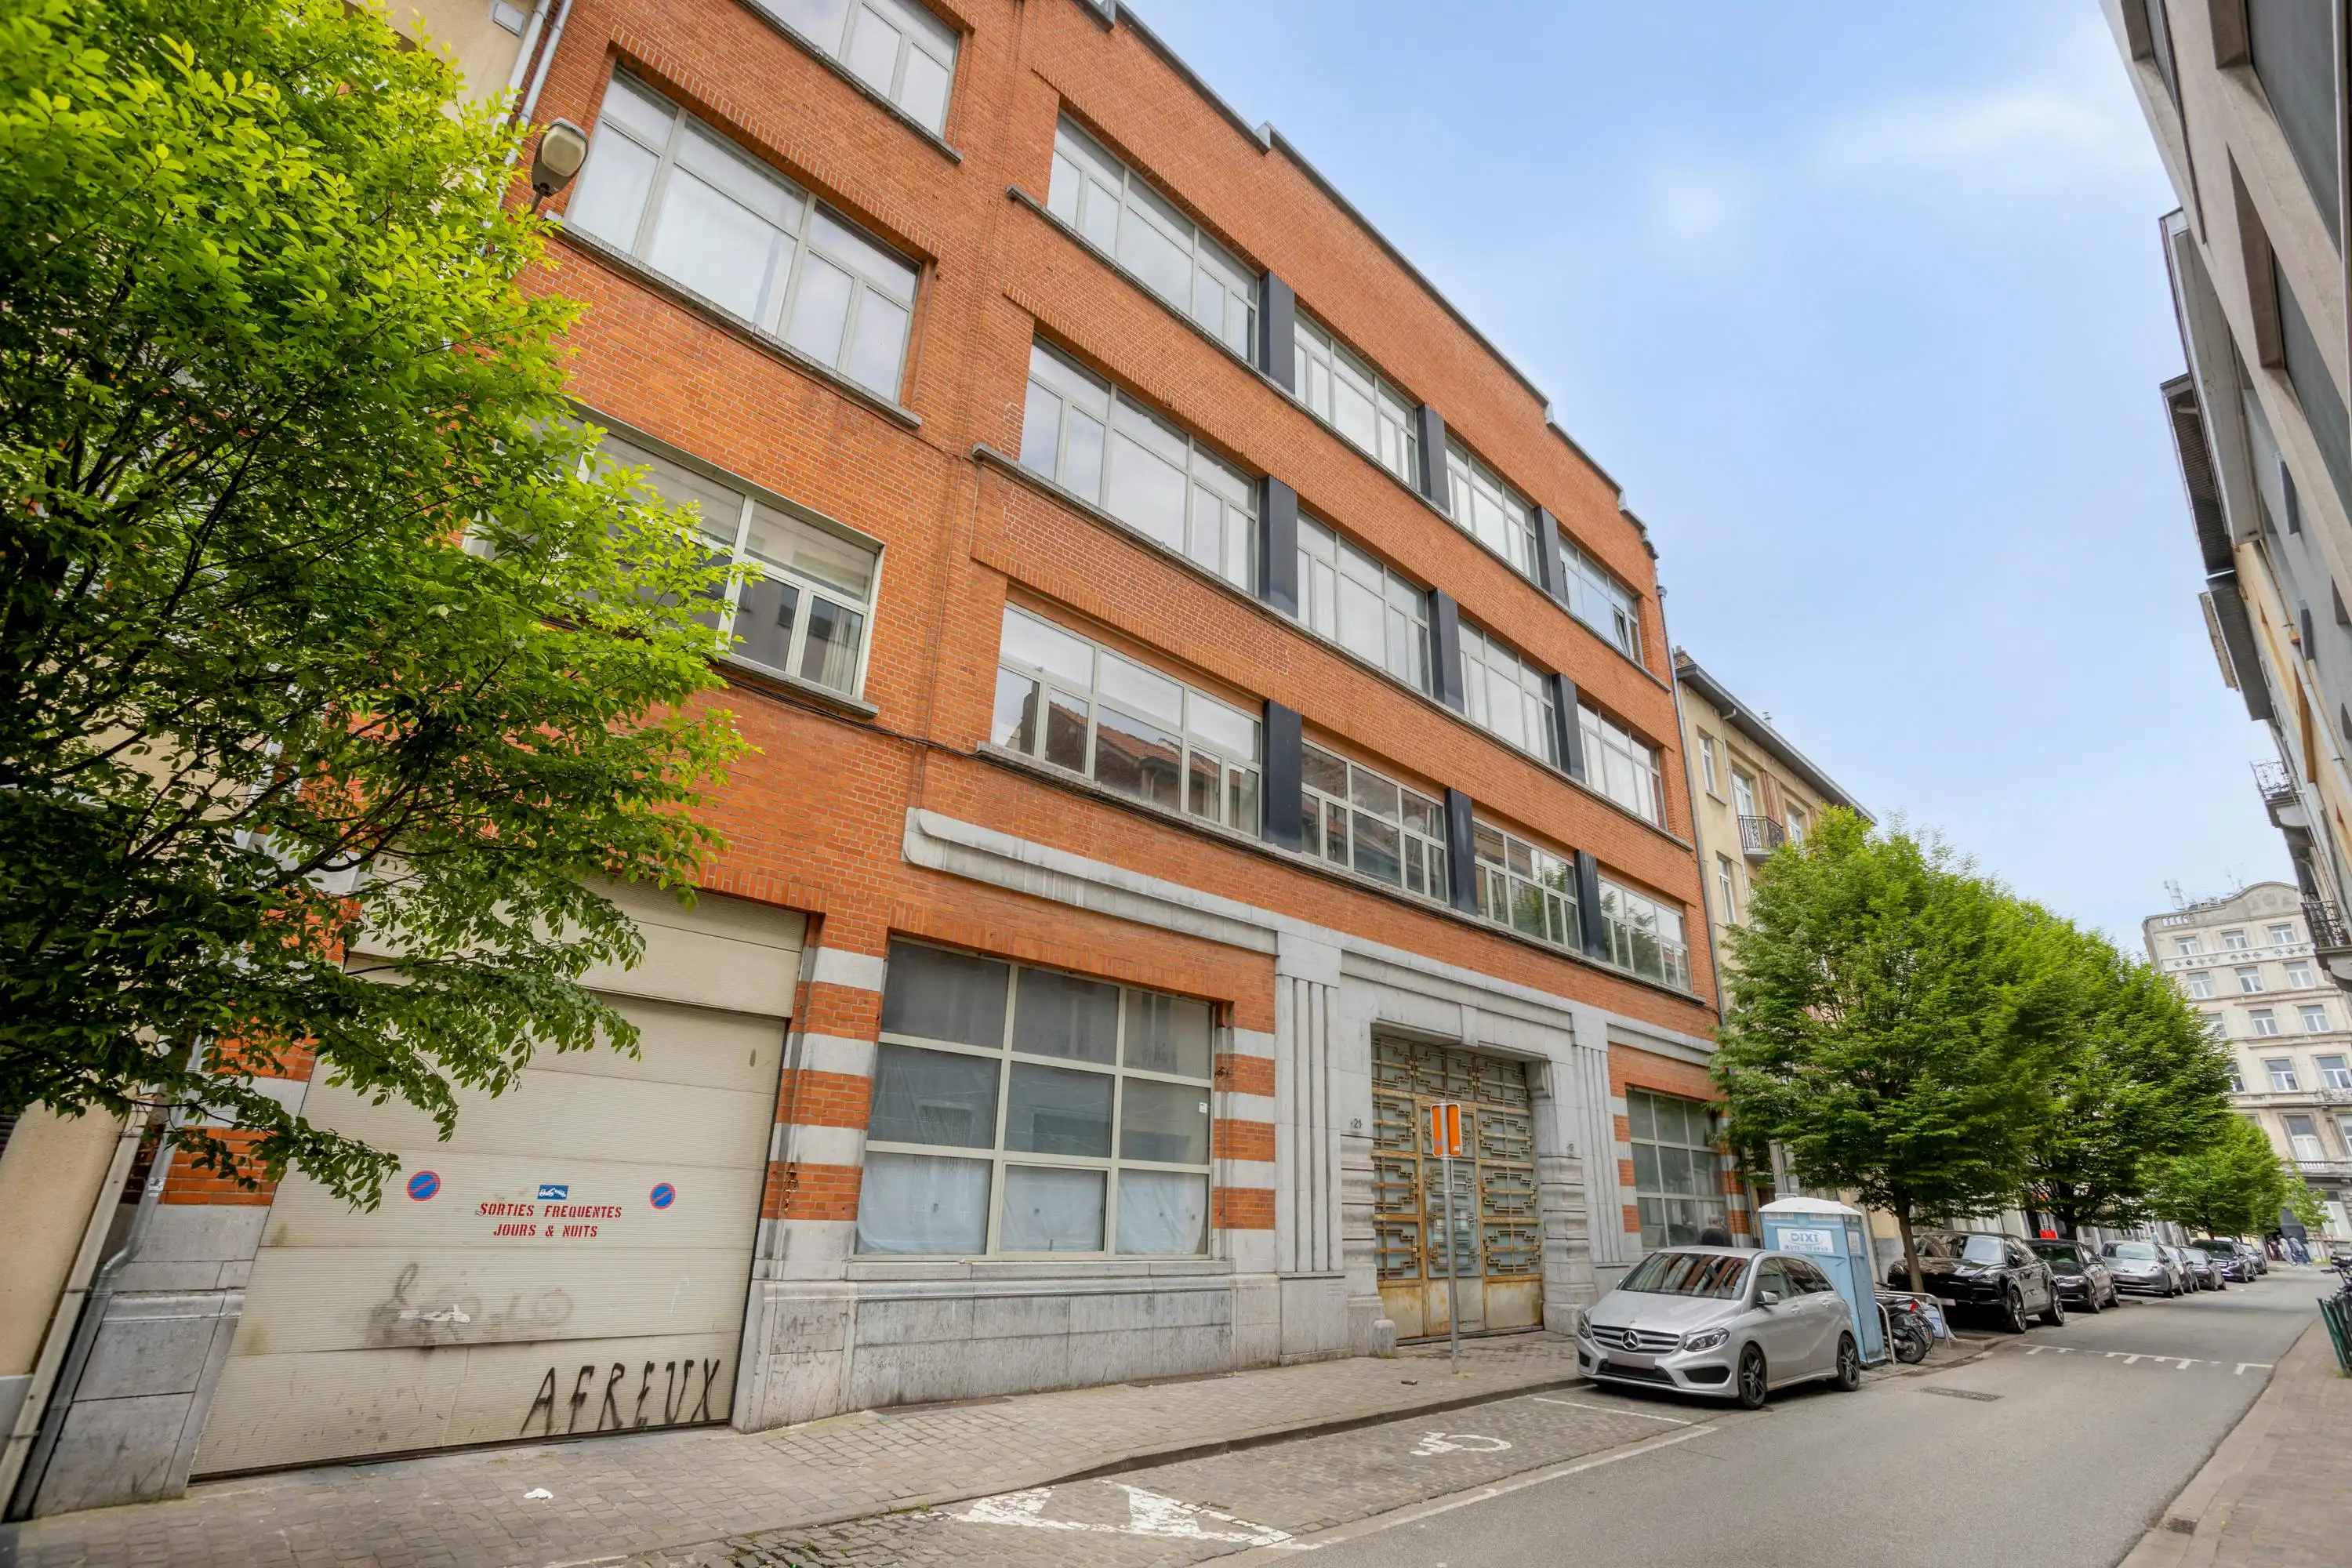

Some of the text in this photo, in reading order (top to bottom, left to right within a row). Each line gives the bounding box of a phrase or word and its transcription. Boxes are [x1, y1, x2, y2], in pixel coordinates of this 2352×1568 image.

[480, 1203, 622, 1218] SORTIES FREQUENTES
[493, 1223, 597, 1237] JOURS & NUITS
[520, 1358, 720, 1436] AFREUX
